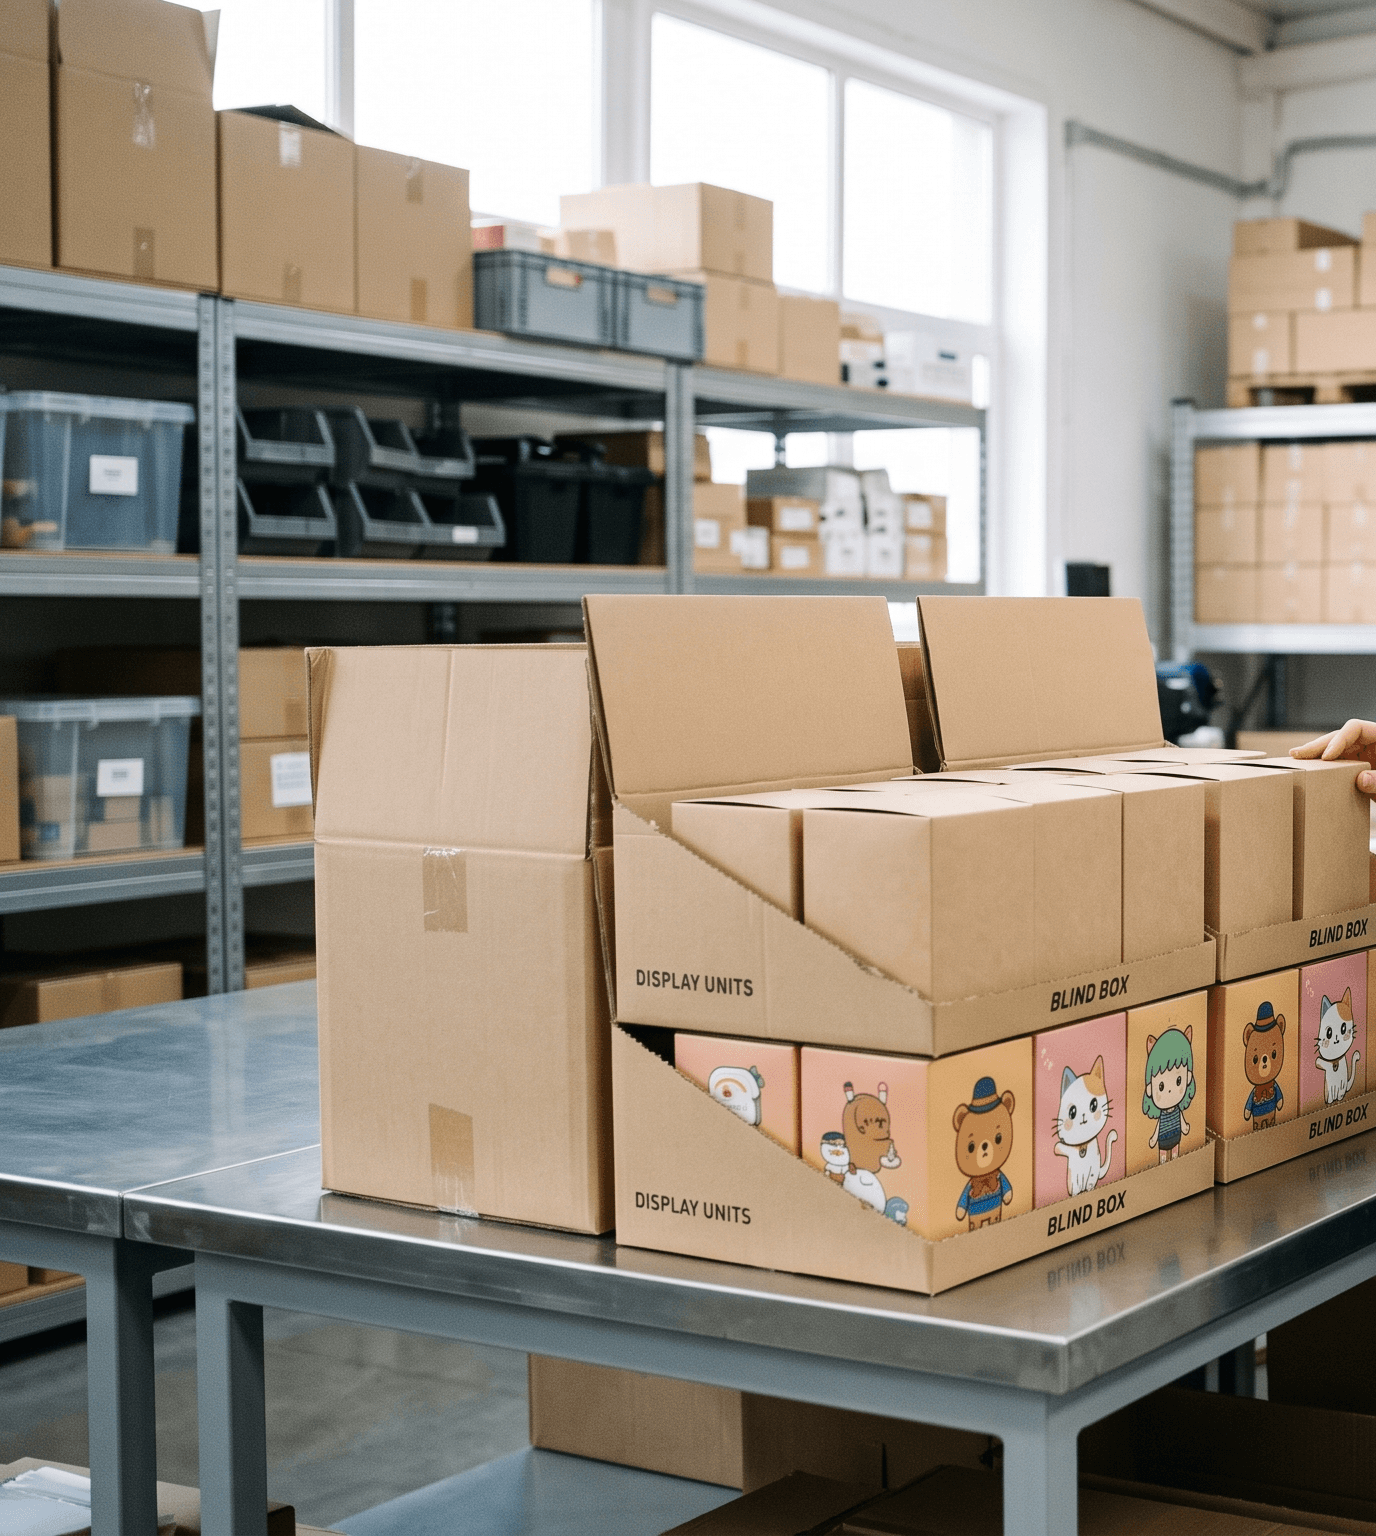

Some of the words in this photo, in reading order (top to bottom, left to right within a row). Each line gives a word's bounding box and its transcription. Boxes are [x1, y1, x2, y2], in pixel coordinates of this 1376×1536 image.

[1309, 924, 1343, 948] BLIND
[1345, 918, 1368, 939] BOX
[636, 969, 700, 991] DISPLAY
[704, 975, 754, 997] UNITS
[1050, 983, 1096, 1012] BLIND
[1099, 974, 1130, 1000] BOX
[1308, 1113, 1343, 1140] BLIND
[1345, 1102, 1369, 1126] BOX
[635, 1191, 699, 1217] DISPLAY
[703, 1202, 751, 1225] UNITS
[1047, 1203, 1093, 1237] BLIND
[1096, 1189, 1127, 1218] BOX
